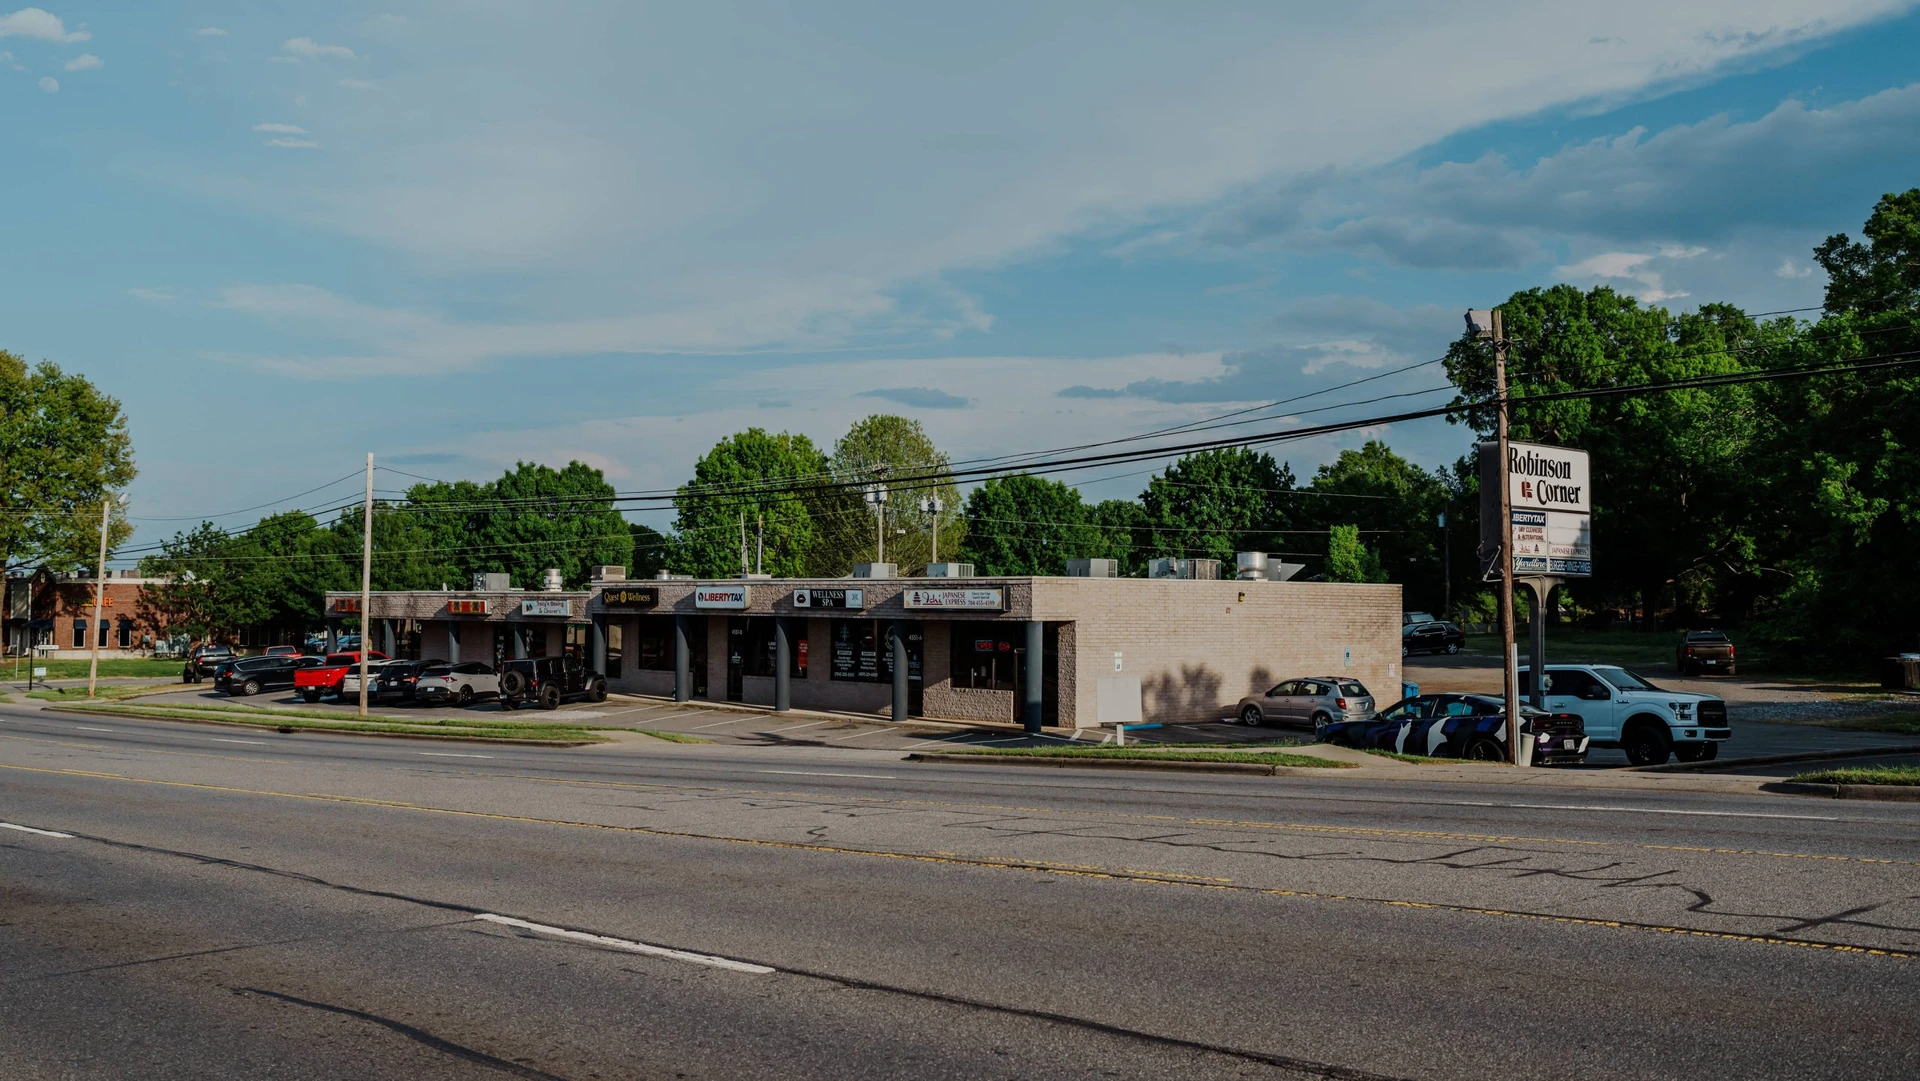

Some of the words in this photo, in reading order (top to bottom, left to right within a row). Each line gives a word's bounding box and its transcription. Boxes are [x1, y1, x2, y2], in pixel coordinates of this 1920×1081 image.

[1509, 447, 1571, 480] Robinson
[1537, 480, 1581, 505] Corner
[604, 592, 619, 602] Quest
[627, 592, 651, 602] Wellness
[704, 592, 743, 602] LIBERTYTAX
[812, 591, 844, 599] WELLNESS
[942, 591, 966, 599] JAPANESE
[822, 599, 834, 607] SPA
